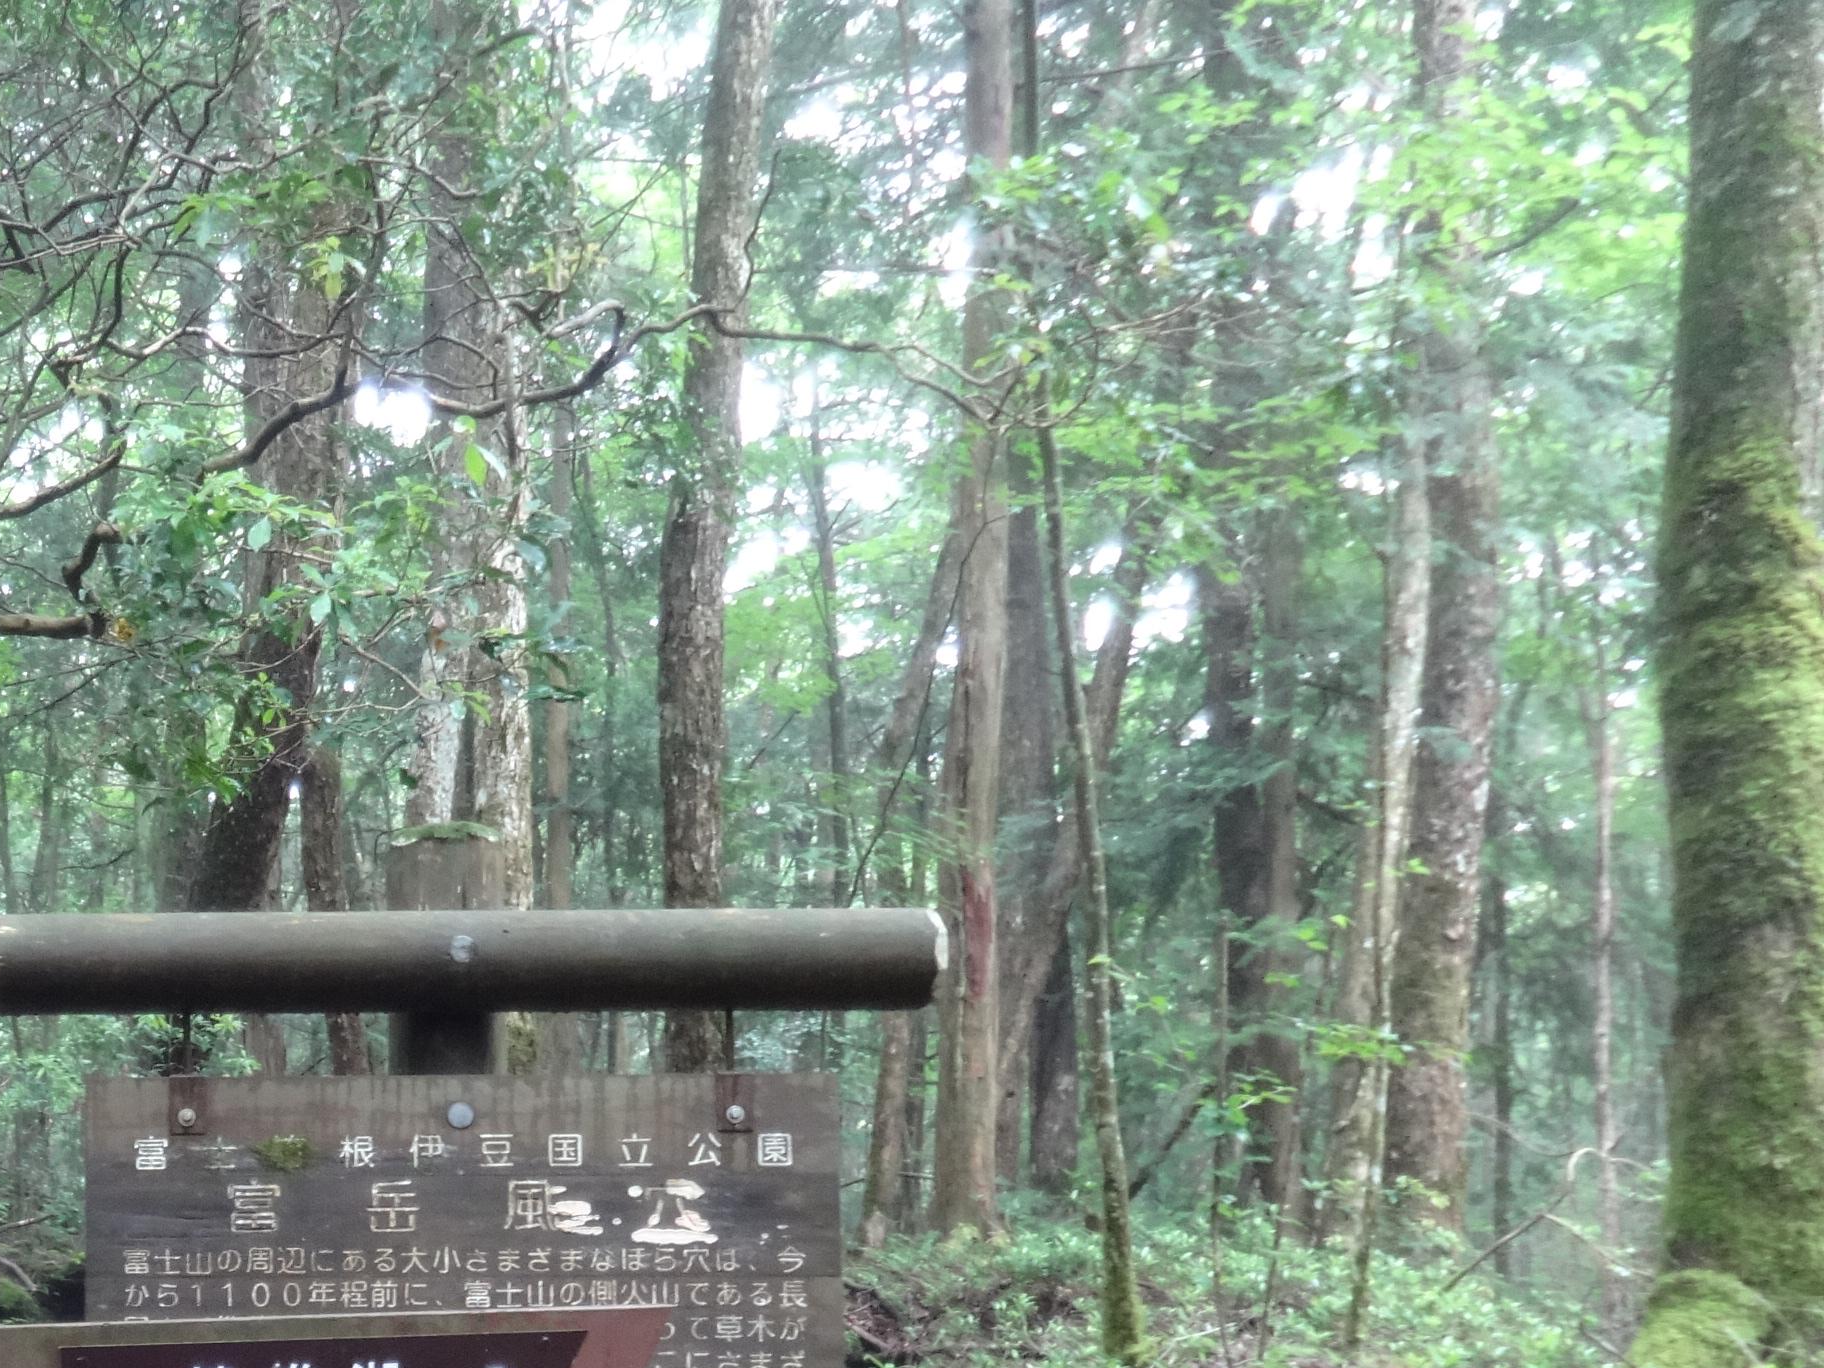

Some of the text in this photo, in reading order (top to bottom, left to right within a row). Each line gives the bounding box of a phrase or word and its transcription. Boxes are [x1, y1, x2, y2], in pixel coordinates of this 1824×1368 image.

[133, 1133, 793, 1171] 富士根伊豆国立公園
